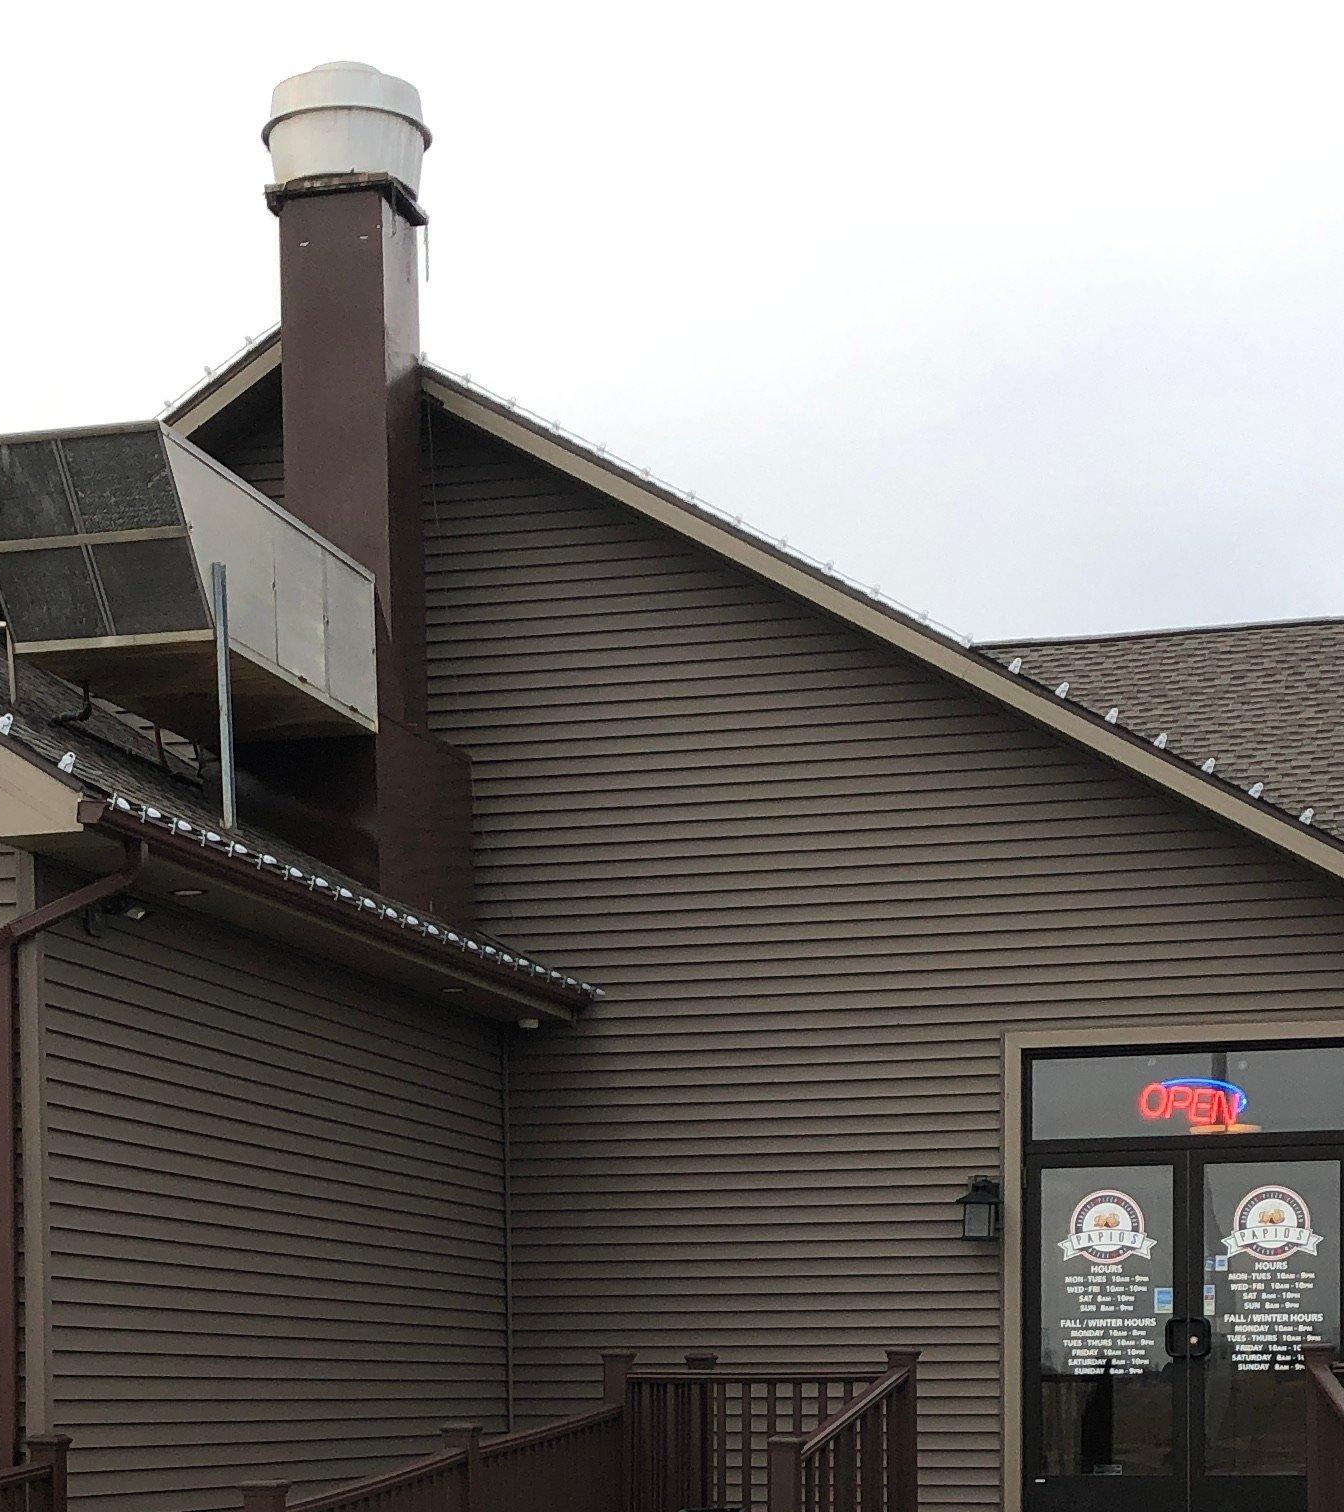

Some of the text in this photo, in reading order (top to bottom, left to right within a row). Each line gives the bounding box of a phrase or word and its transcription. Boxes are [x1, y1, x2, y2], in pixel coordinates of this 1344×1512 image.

[1141, 1083, 1240, 1125] OPEN
[1091, 1265, 1123, 1273] HOURS
[1255, 1262, 1287, 1270] HOURS
[1224, 1314, 1246, 1322] FALL
[1253, 1314, 1288, 1322] WINTER
[1291, 1313, 1323, 1321] HOURS
[1088, 1319, 1122, 1327] WINTER
[1124, 1318, 1156, 1326] HOURS
